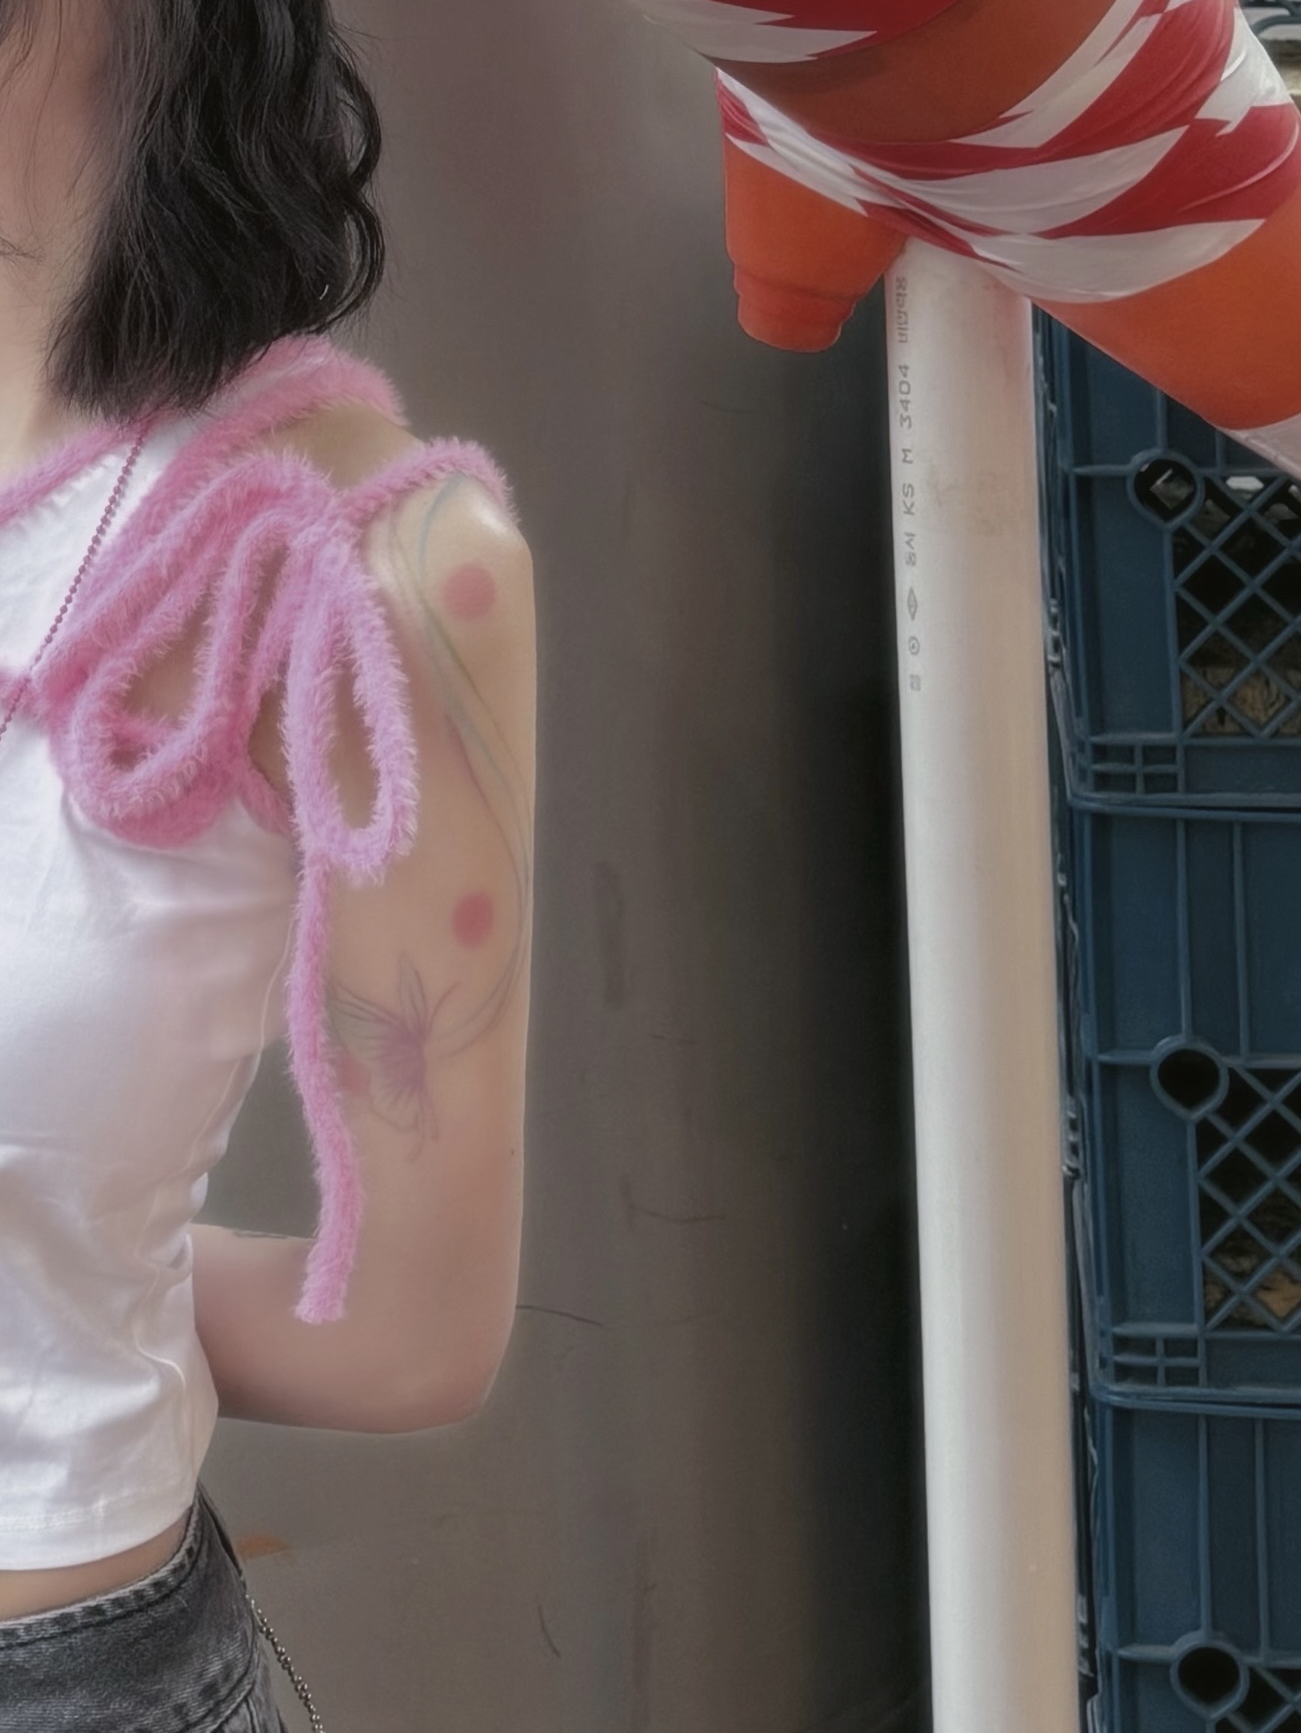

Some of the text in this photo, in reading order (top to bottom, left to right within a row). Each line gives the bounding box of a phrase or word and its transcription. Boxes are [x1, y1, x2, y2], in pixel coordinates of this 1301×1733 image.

[899, 364, 912, 429] 3404
[902, 447, 913, 464] M
[902, 482, 915, 516] KS
